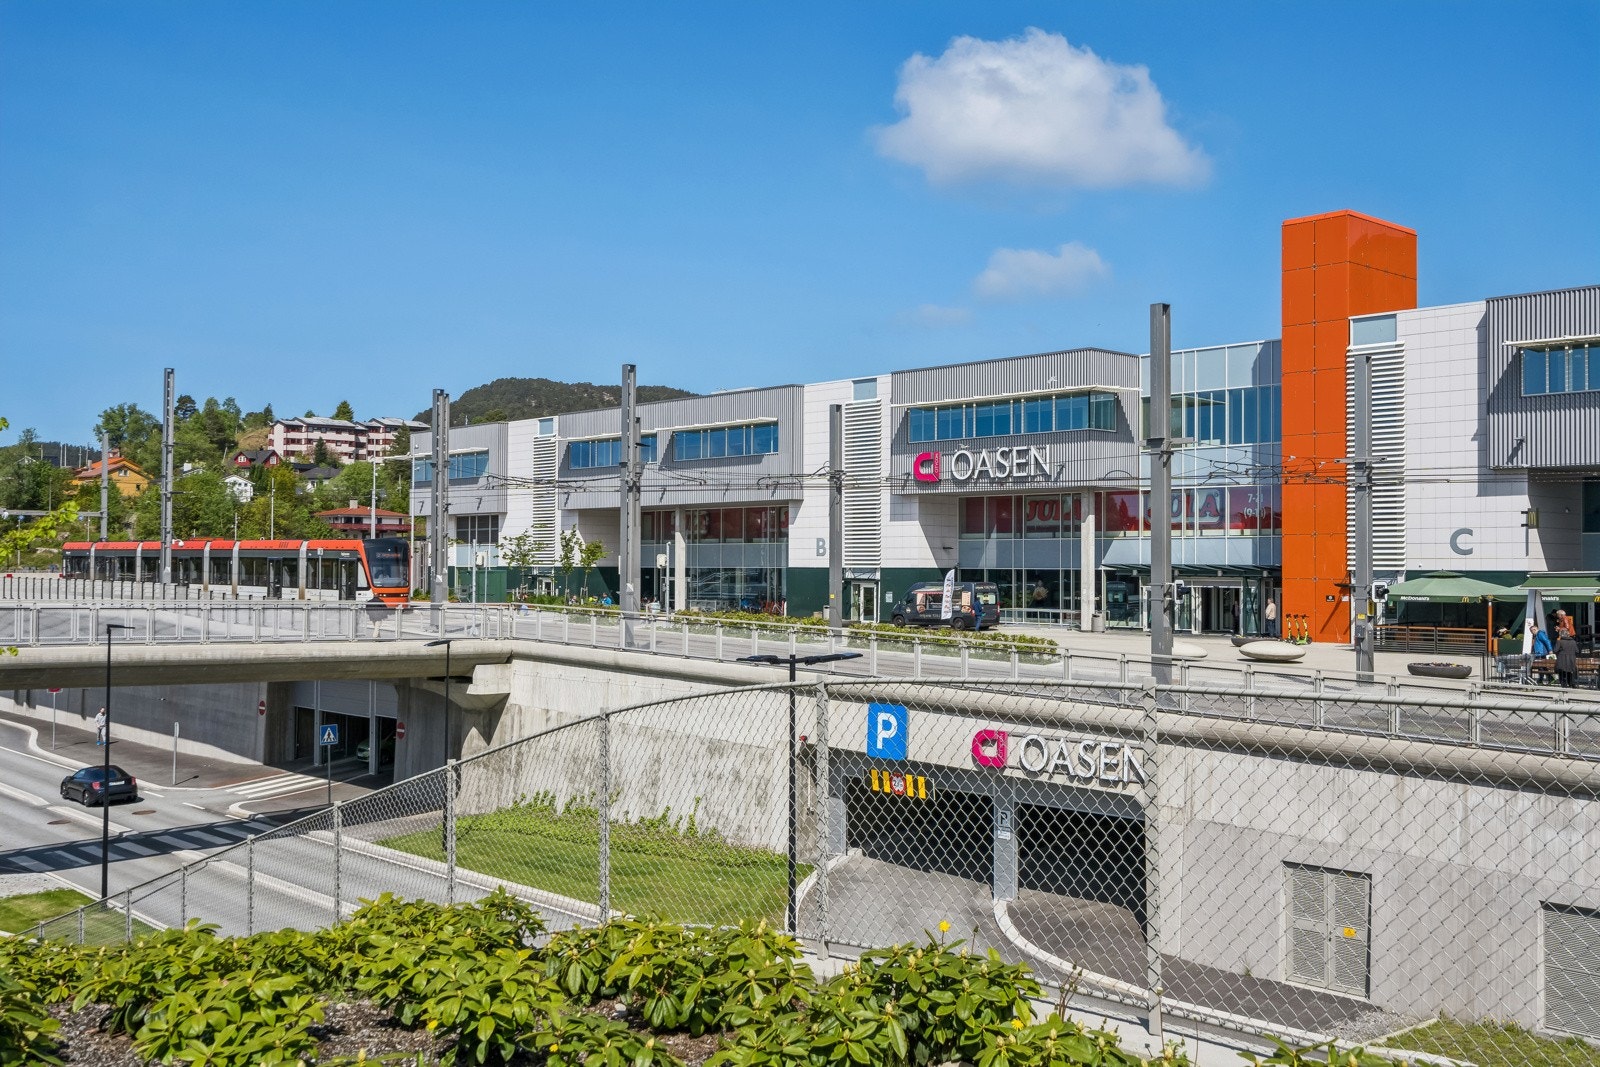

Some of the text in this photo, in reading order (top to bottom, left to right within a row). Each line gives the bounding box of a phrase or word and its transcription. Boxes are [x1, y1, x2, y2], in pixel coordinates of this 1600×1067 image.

[951, 444, 1050, 480] OASEN
[816, 538, 826, 556] B
[1450, 528, 1473, 555] C
[876, 712, 898, 749] P
[1020, 735, 1146, 783] OASEN
